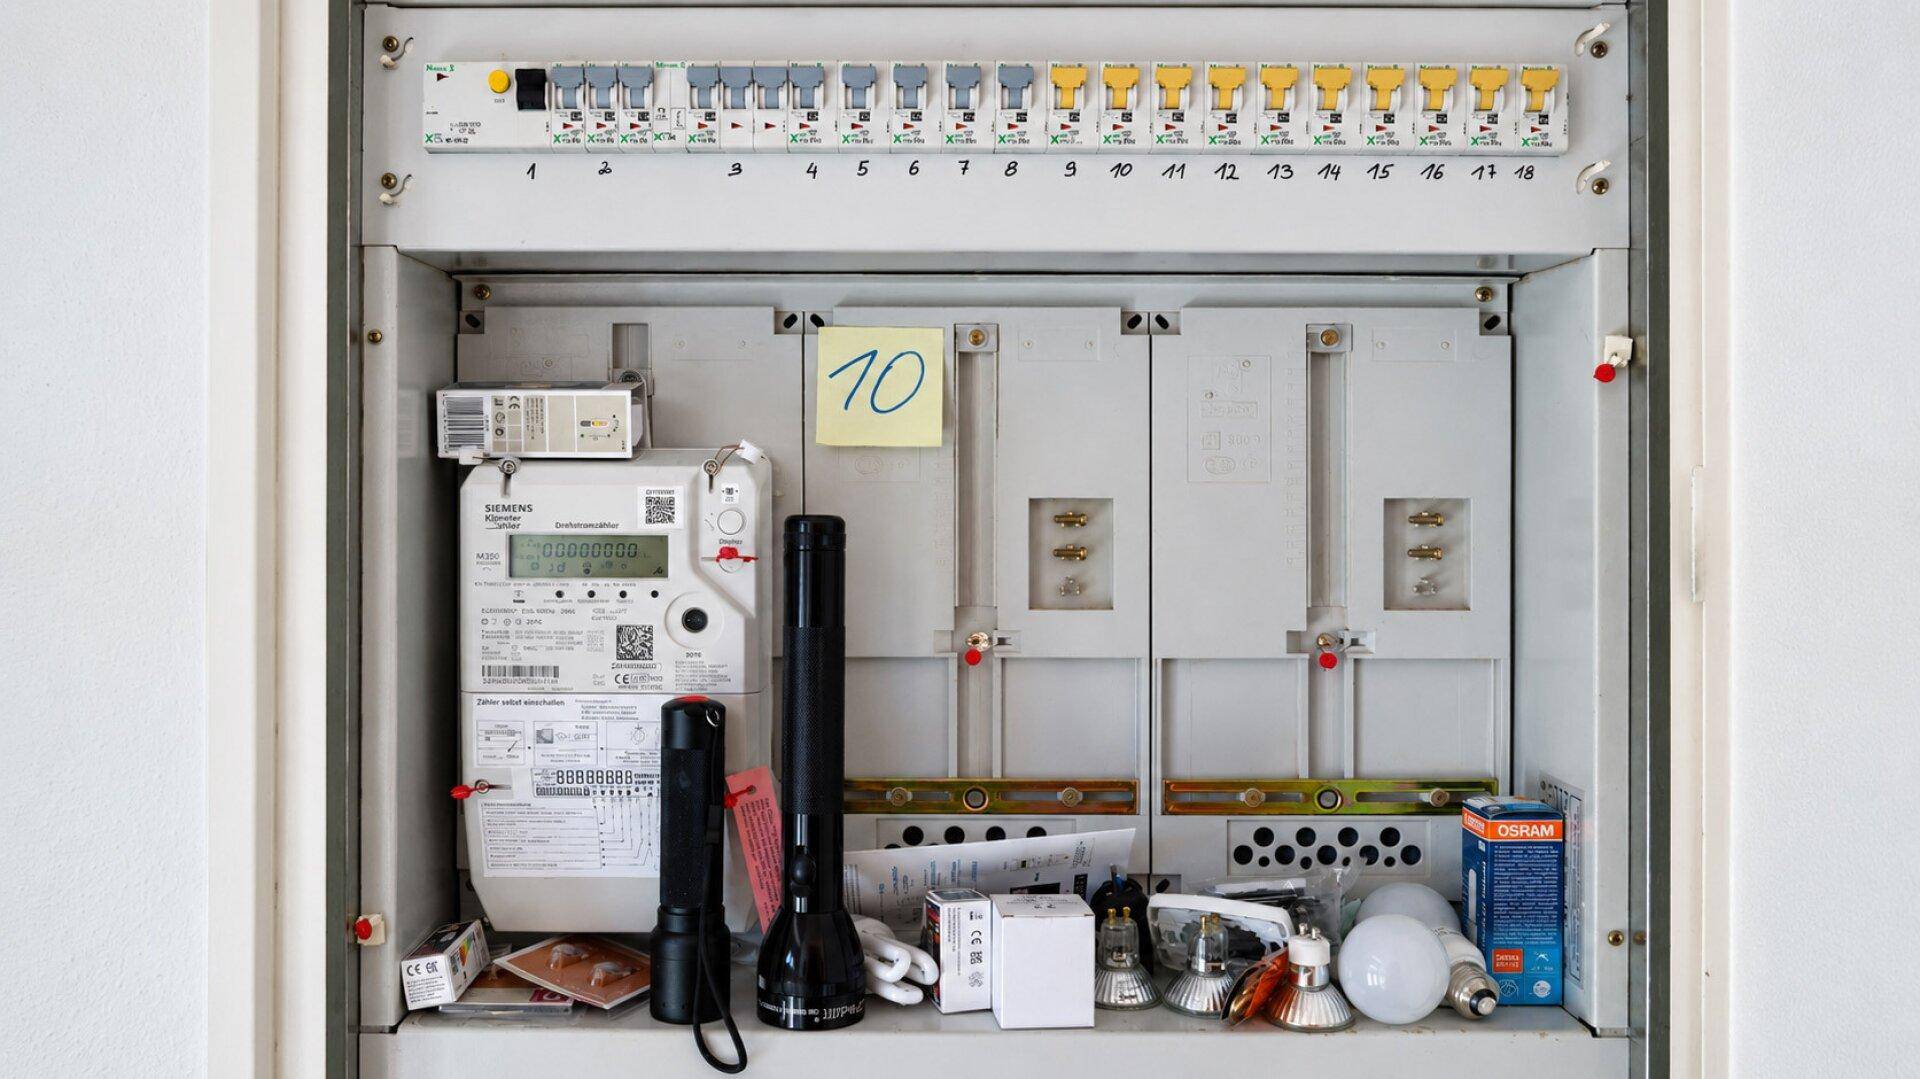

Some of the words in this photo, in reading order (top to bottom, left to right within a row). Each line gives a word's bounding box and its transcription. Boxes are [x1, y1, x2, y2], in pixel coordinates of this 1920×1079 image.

[527, 163, 536, 179] 1
[599, 161, 612, 175] 2
[728, 163, 742, 176] 3
[807, 163, 818, 179] 4
[857, 160, 869, 176] 5
[908, 160, 920, 175] 6
[958, 160, 970, 175] 7
[1005, 161, 1018, 176] 8
[1065, 162, 1077, 177] 9
[1110, 163, 1133, 178] 10
[1162, 164, 1186, 179] 11
[1214, 163, 1240, 180] 12
[1267, 164, 1294, 179] 13
[1318, 164, 1341, 180] 14
[1367, 163, 1394, 179] 15
[1420, 163, 1445, 180] 16
[1471, 164, 1496, 180] 17
[1514, 165, 1535, 180] 18
[828, 350, 925, 414] 10
[485, 504, 533, 513] SIEMENS
[1498, 824, 1554, 837] OSRAM
